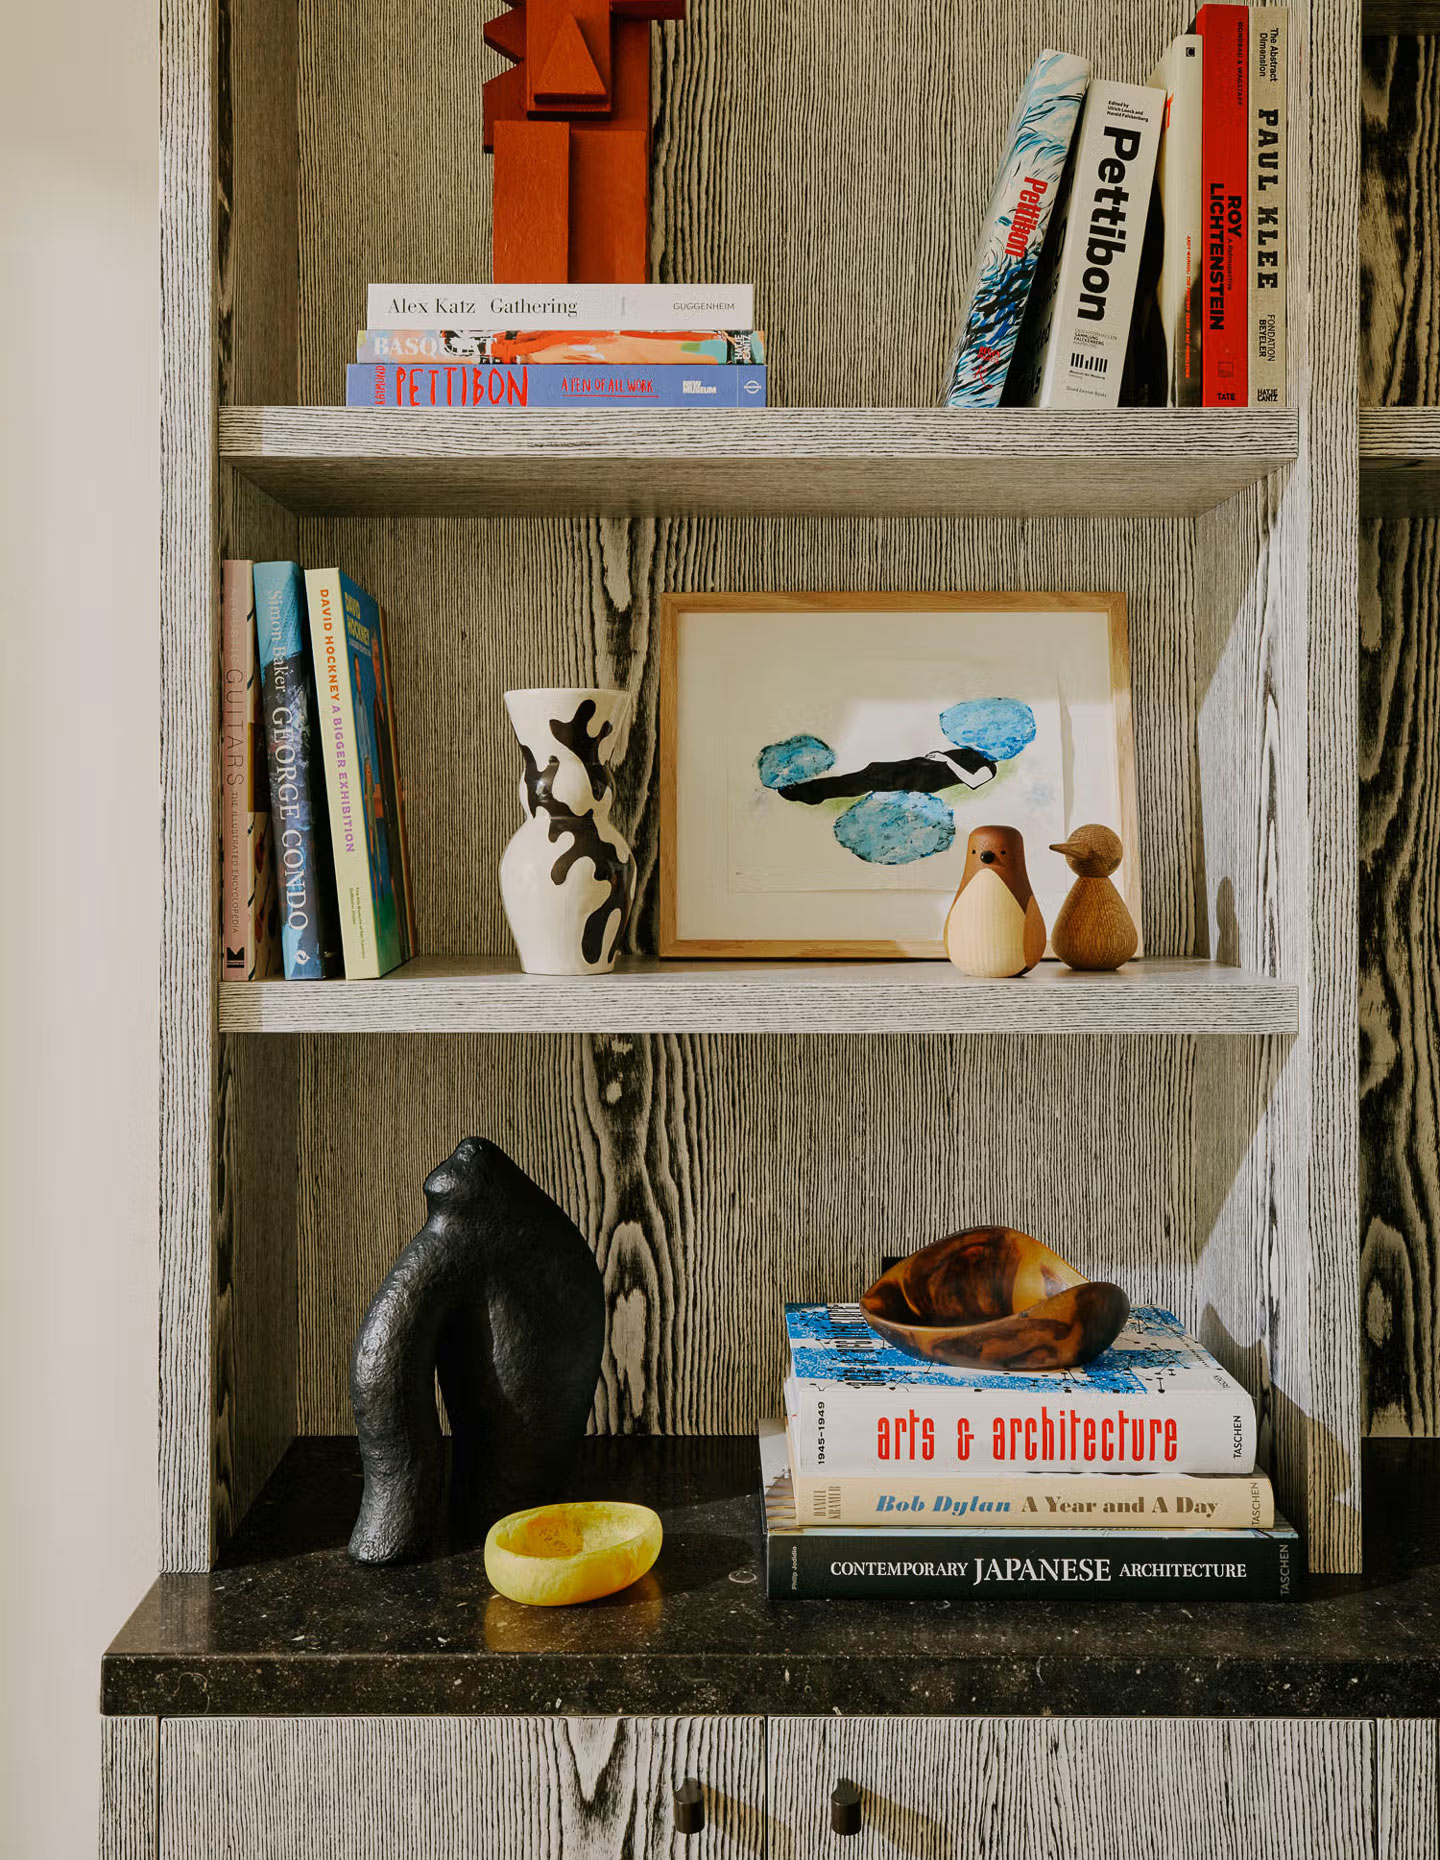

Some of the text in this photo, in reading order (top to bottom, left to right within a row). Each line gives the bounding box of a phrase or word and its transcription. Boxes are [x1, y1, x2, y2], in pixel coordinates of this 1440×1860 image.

[1259, 33, 1268, 77] Dimension
[1270, 28, 1279, 82] The Abstract
[1122, 113, 1149, 123] Falckenberg
[1005, 176, 1048, 258] Pettibon
[1228, 196, 1242, 238] ROY
[1257, 109, 1279, 288] PAUL KLEE
[1077, 126, 1142, 321] Pettibon
[1210, 183, 1224, 330] LICHTENSTEIN
[387, 298, 578, 318] Alex Katz Gathering
[673, 302, 735, 310] GUGGENHEIM
[734, 334, 743, 360] HATJE
[742, 334, 751, 361] CANTZ
[1259, 320, 1267, 357] BEYELER
[1267, 315, 1275, 362] FONDATION
[374, 365, 387, 405] RAYMOND
[396, 366, 528, 407] PETTIBON
[561, 377, 654, 393] A PEN OF ALL WORK
[1257, 394, 1278, 402] CANTZ
[225, 669, 244, 786] GUITARS
[320, 589, 354, 853] DAVID HOCKNEY A BIGGER EXHIBITION
[267, 591, 309, 931] Simon Baker GEORGE CONDO
[231, 792, 239, 808] THE
[231, 811, 239, 867] ILLUSTRATED
[231, 868, 239, 933] ENCYCLOPEDIA
[877, 1406, 1177, 1461] arts & architecture
[1233, 1415, 1242, 1459] TASCHEN
[813, 1490, 826, 1517] DANIEL
[828, 1486, 841, 1520] KRAMER
[875, 1495, 1219, 1518] Bob Dylan A Year and A Day
[1251, 1482, 1259, 1526] TASCHEN
[830, 1557, 1247, 1586] CONTEMPORARY JAPANESE ARCHITECTURE
[1280, 1544, 1289, 1597] TASCHEN
